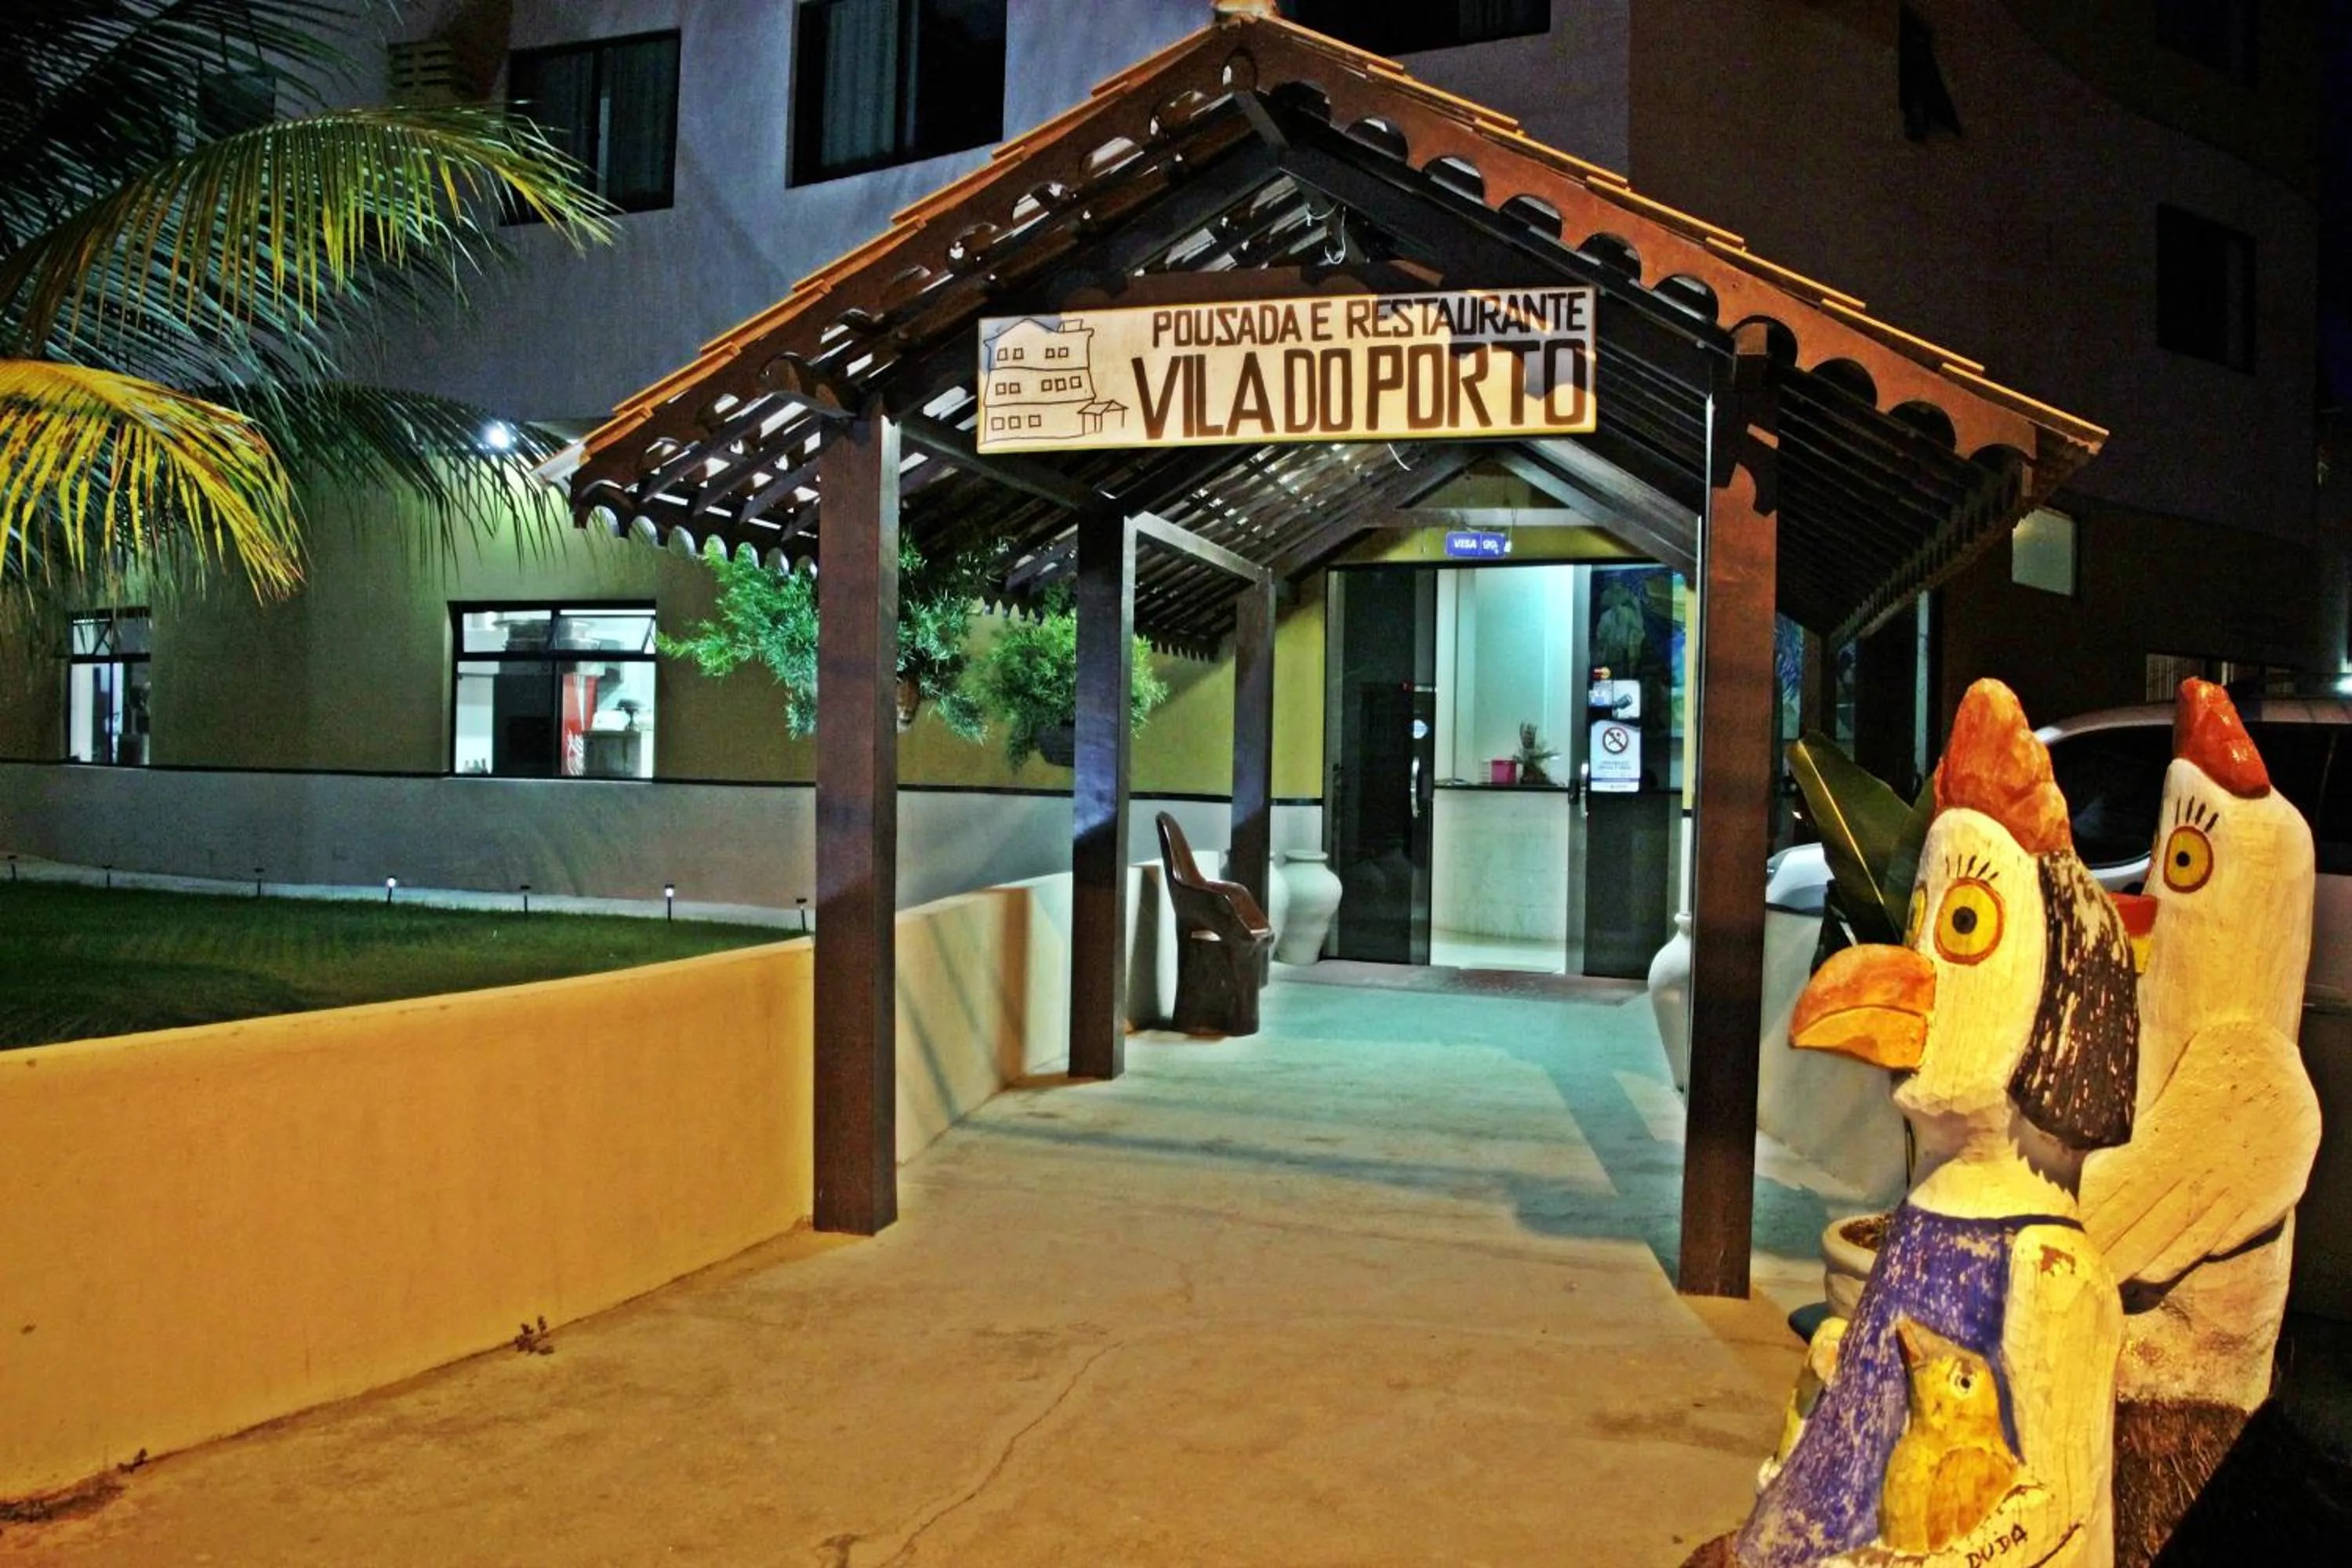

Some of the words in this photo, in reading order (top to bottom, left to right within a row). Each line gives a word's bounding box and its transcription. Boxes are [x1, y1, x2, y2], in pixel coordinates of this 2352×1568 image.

[1152, 304, 1302, 347] POUSADA
[1311, 301, 1332, 341] E
[1346, 292, 1587, 339] RESTAURANTE
[1131, 350, 1276, 440] VILA
[1283, 347, 1352, 434] DO
[1366, 338, 1586, 430] PORTO
[1453, 538, 1477, 550] VISA
[1965, 1523, 2028, 1568] DUDA
